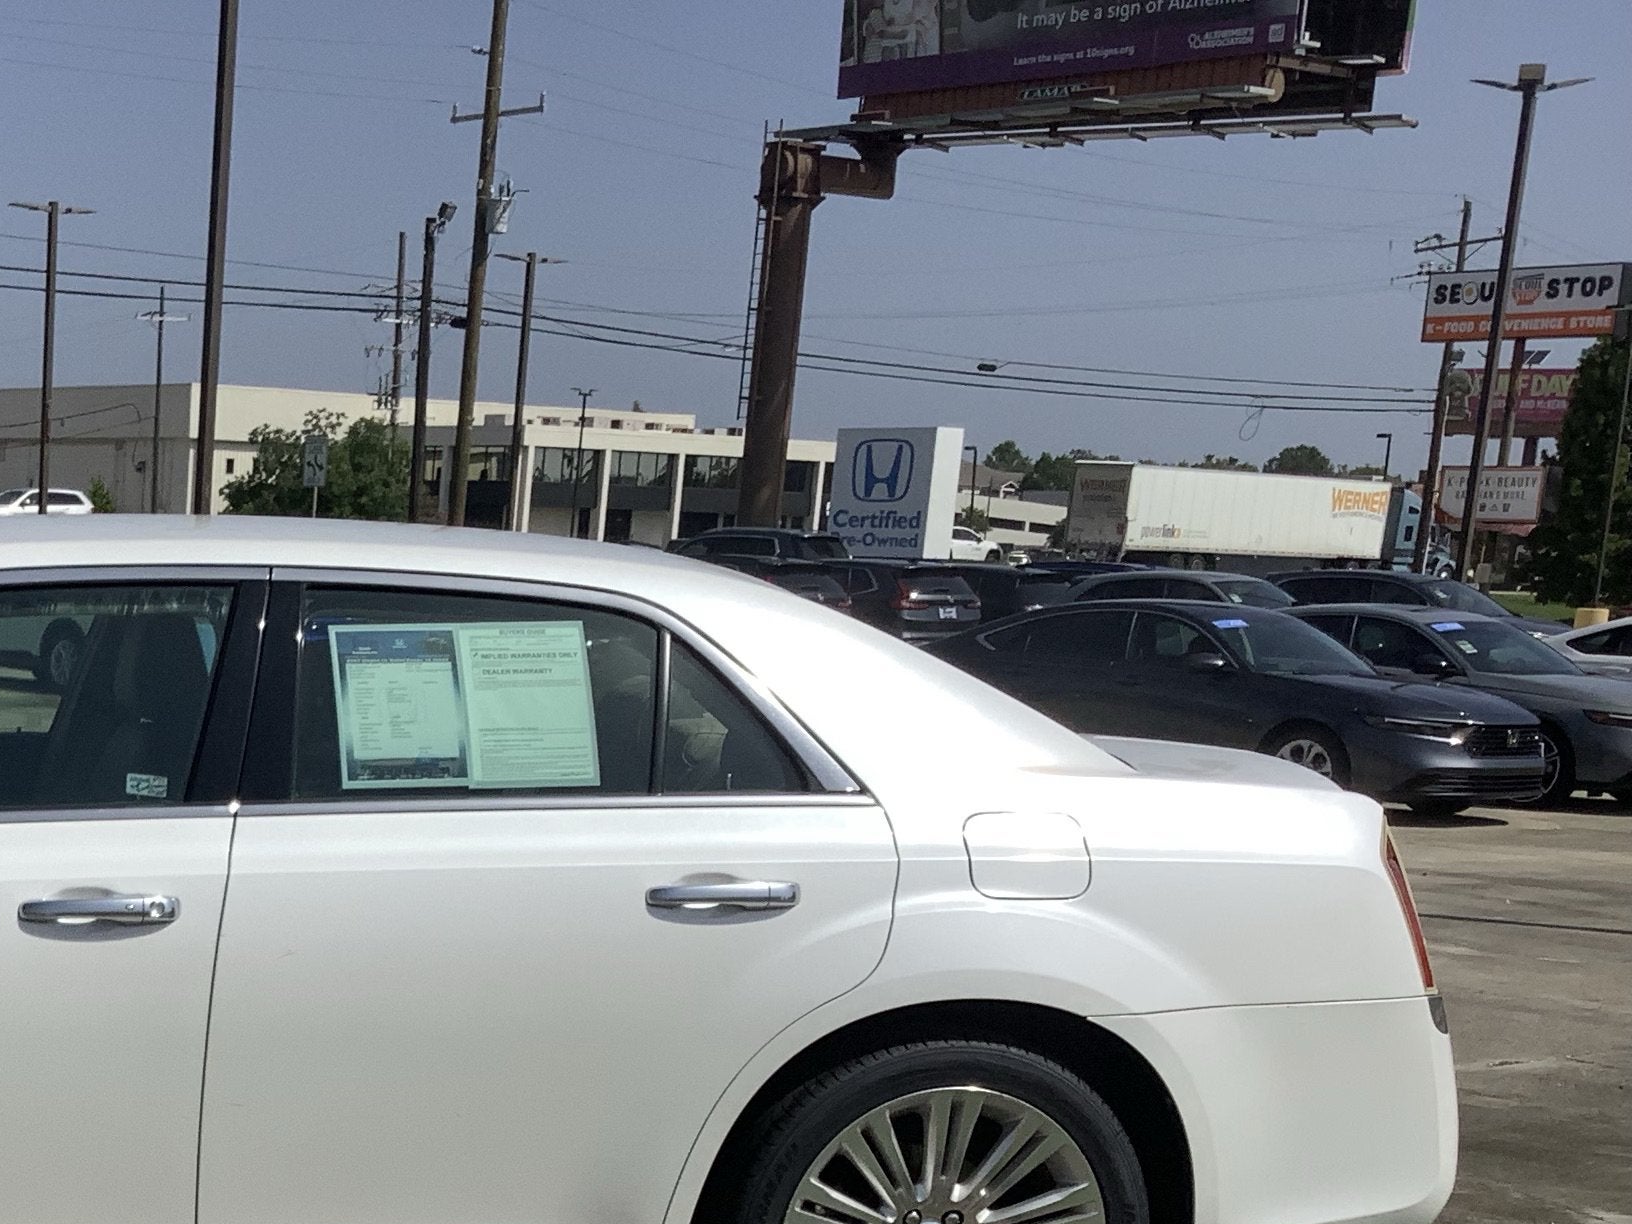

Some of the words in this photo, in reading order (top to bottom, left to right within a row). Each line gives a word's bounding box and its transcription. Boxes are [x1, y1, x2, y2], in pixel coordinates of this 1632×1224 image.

[1017, 12, 1029, 29] It
[1032, 11, 1067, 30] may
[1070, 5, 1090, 23] be
[1093, 7, 1104, 20] a
[1107, 3, 1142, 22] sign
[1145, 0, 1164, 13] of
[1433, 280, 1496, 306] SEOU
[1543, 275, 1614, 300] STOP
[1569, 315, 1612, 329] STORE
[1332, 487, 1389, 516] WERNER
[832, 508, 922, 530] Certified
